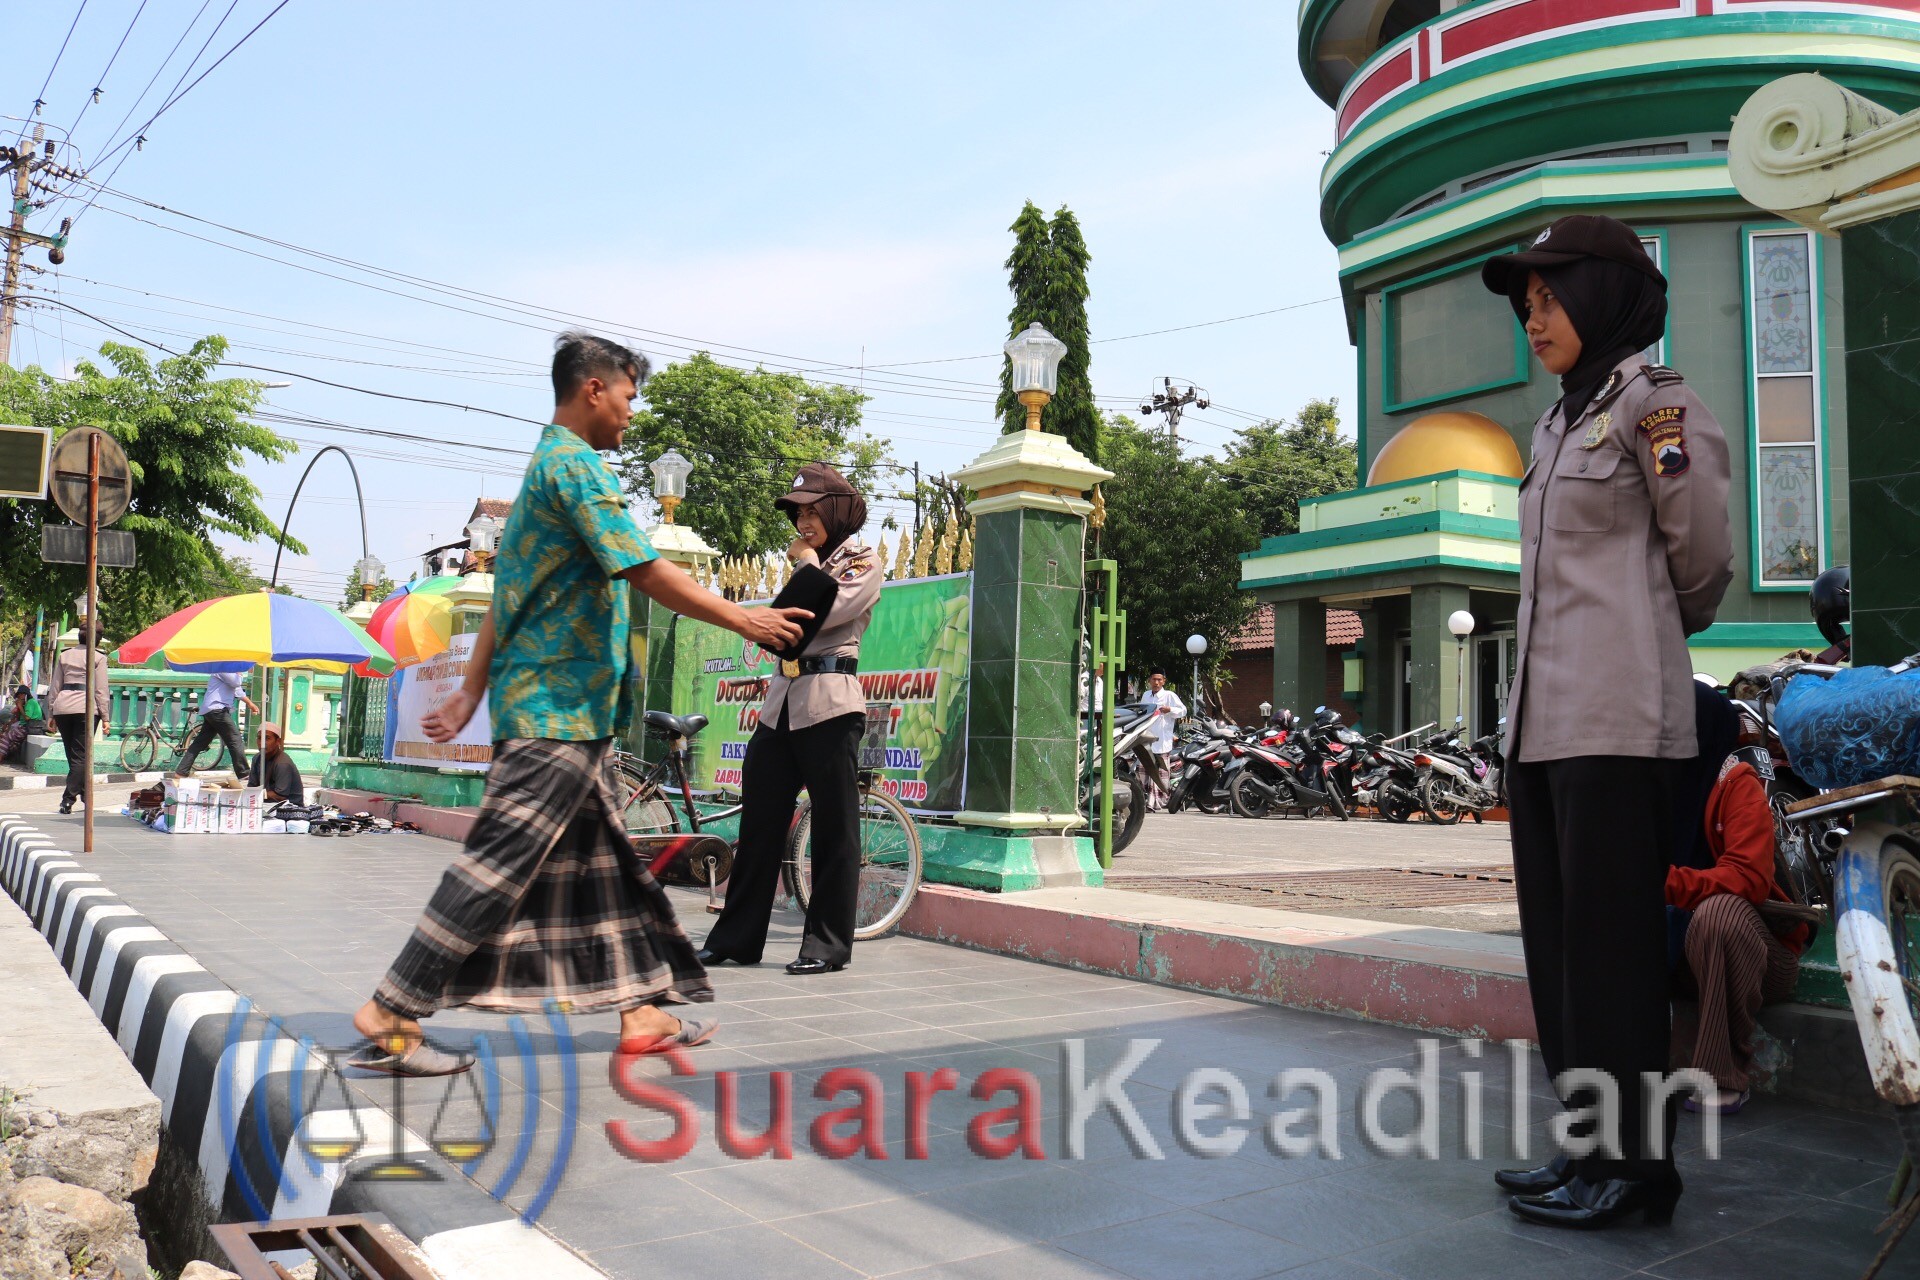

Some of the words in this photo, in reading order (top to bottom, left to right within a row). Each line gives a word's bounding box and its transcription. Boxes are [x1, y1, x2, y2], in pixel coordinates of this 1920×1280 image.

[1640, 408, 1681, 427] POLRES
[1646, 415, 1678, 430] KENDAL
[721, 743, 748, 759] TAK
[901, 781, 927, 799] WIB
